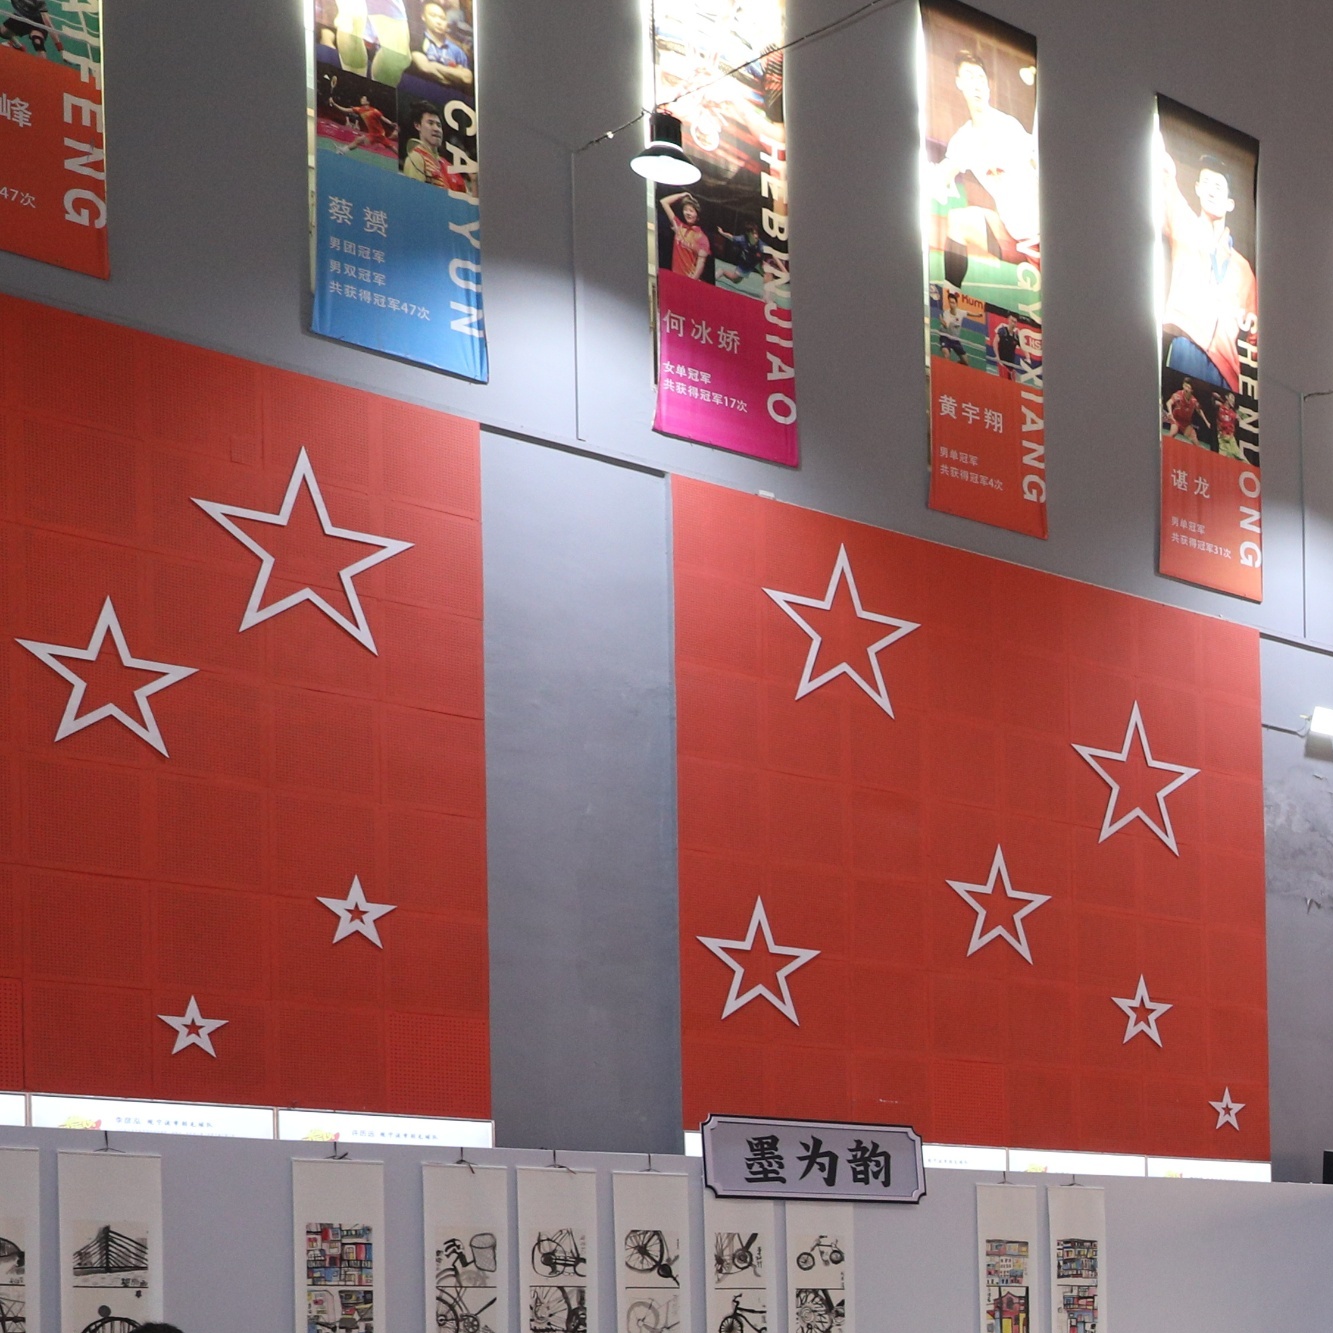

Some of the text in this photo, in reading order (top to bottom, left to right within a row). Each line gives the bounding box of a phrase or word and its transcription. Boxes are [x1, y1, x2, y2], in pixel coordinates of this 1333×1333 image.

[444, 99, 484, 339] CAIYUN
[329, 236, 386, 264] 男团冠军
[329, 259, 387, 287] 男双冠军
[329, 280, 431, 321] 共获得冠军47次
[662, 308, 742, 355] 何冰娇
[662, 360, 712, 386] 女单冠军
[662, 379, 749, 413] 共获得冠军17次
[938, 394, 1003, 434] 黄宇翔
[939, 446, 979, 467] 男单冠军
[1171, 468, 1212, 500] 谌龙
[743, 1134, 892, 1188] 墨为韵
